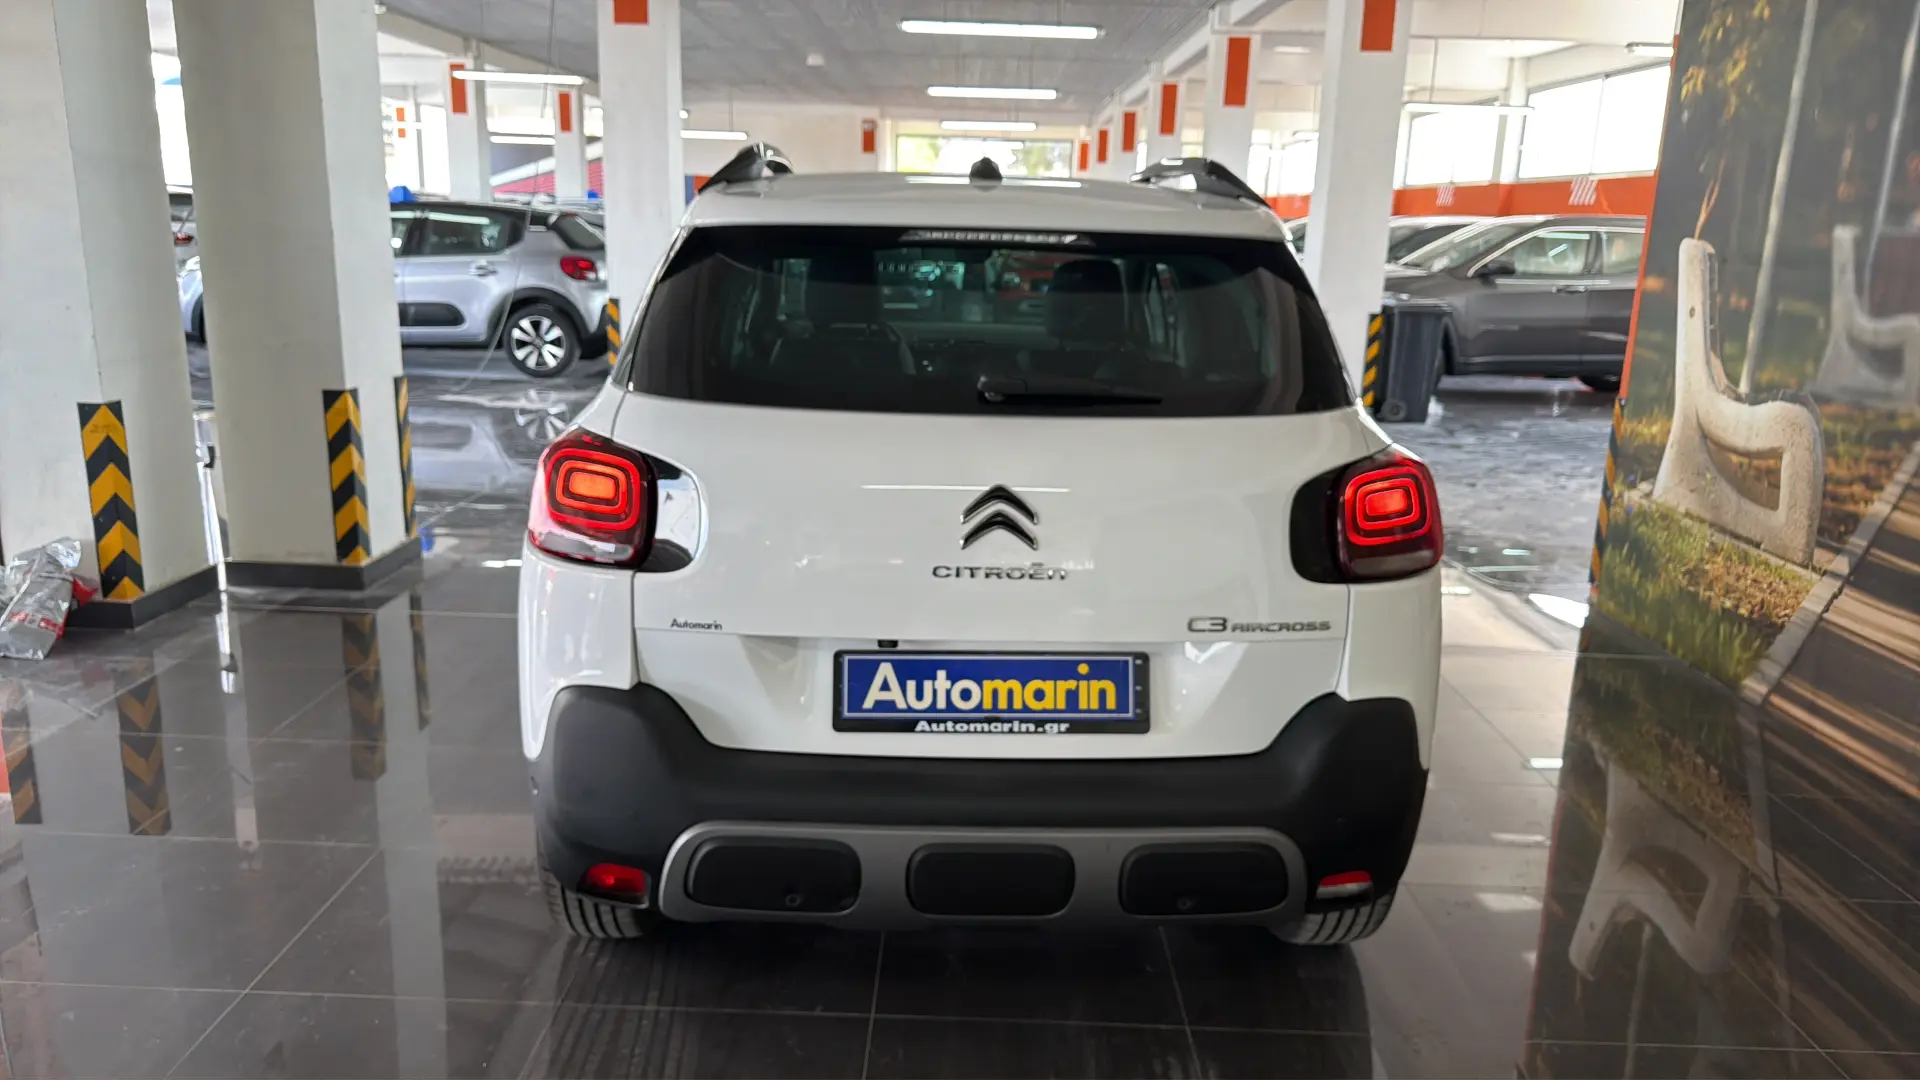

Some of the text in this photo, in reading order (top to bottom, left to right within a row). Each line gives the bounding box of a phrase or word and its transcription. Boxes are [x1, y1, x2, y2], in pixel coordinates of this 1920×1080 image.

[670, 617, 723, 631] Automarin
[1187, 616, 1331, 633] C3 AIRCROSS
[862, 661, 1117, 711] Automarin
[914, 720, 1070, 734] Automarin.gr
